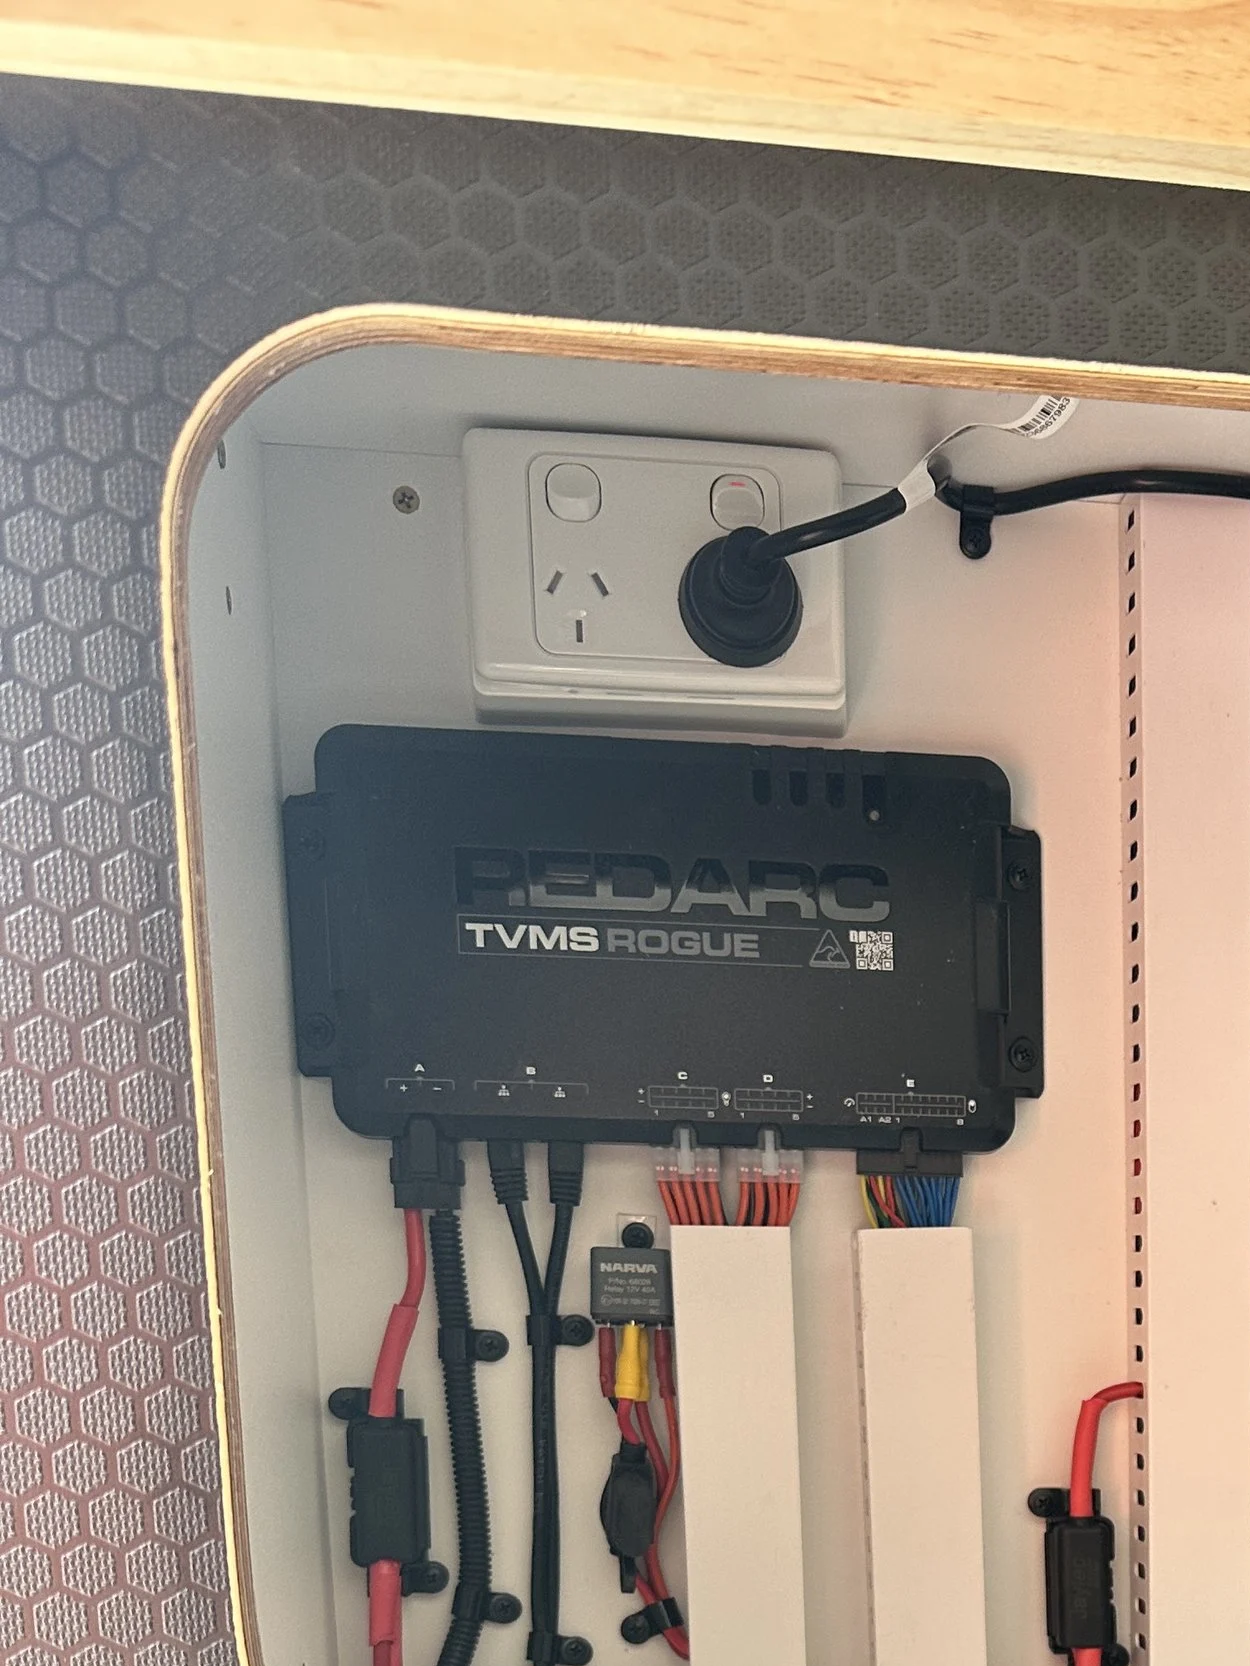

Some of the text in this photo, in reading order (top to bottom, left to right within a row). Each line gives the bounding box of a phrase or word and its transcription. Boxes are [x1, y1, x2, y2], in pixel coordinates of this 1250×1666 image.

[453, 846, 891, 923] REDARC
[465, 922, 761, 959] TVMS ROGUE
[414, 1063, 425, 1073] A
[526, 1066, 536, 1075] B
[677, 1071, 688, 1081] C
[763, 1074, 774, 1083] D
[600, 1262, 658, 1274] NARVA
